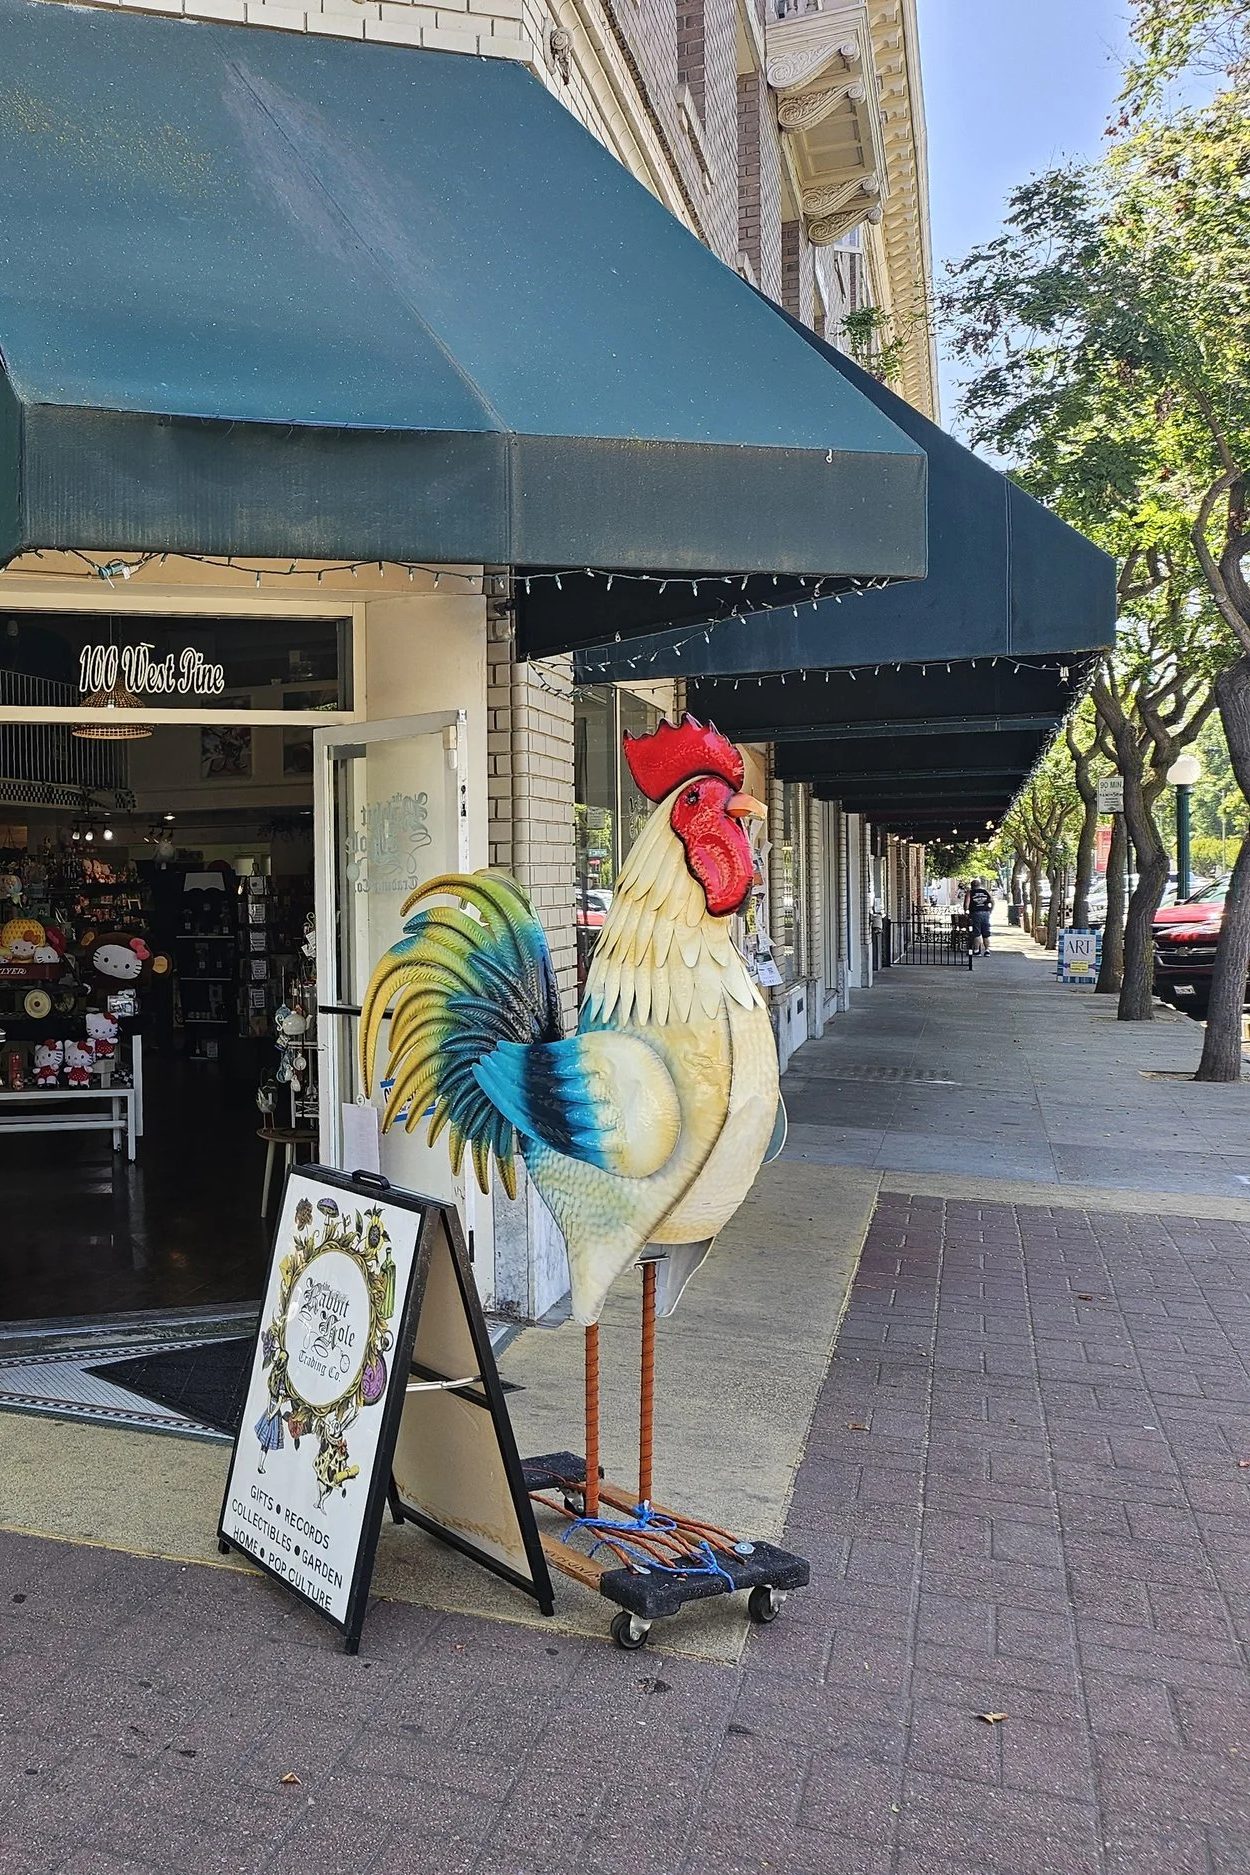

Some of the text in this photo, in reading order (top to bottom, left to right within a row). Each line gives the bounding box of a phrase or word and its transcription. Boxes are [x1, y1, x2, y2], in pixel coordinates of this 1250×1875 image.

[79, 642, 225, 694] 100 West Pine
[1066, 939, 1092, 956] ART
[302, 1277, 350, 1318] Rabbit
[318, 1310, 355, 1351] Hole
[298, 1349, 341, 1382] Trading Co.
[250, 1485, 330, 1549] GIFTS RECORDS
[232, 1499, 343, 1589] COLLECTIBLES GARDEN
[233, 1525, 333, 1612] HOME POP CULTURE
